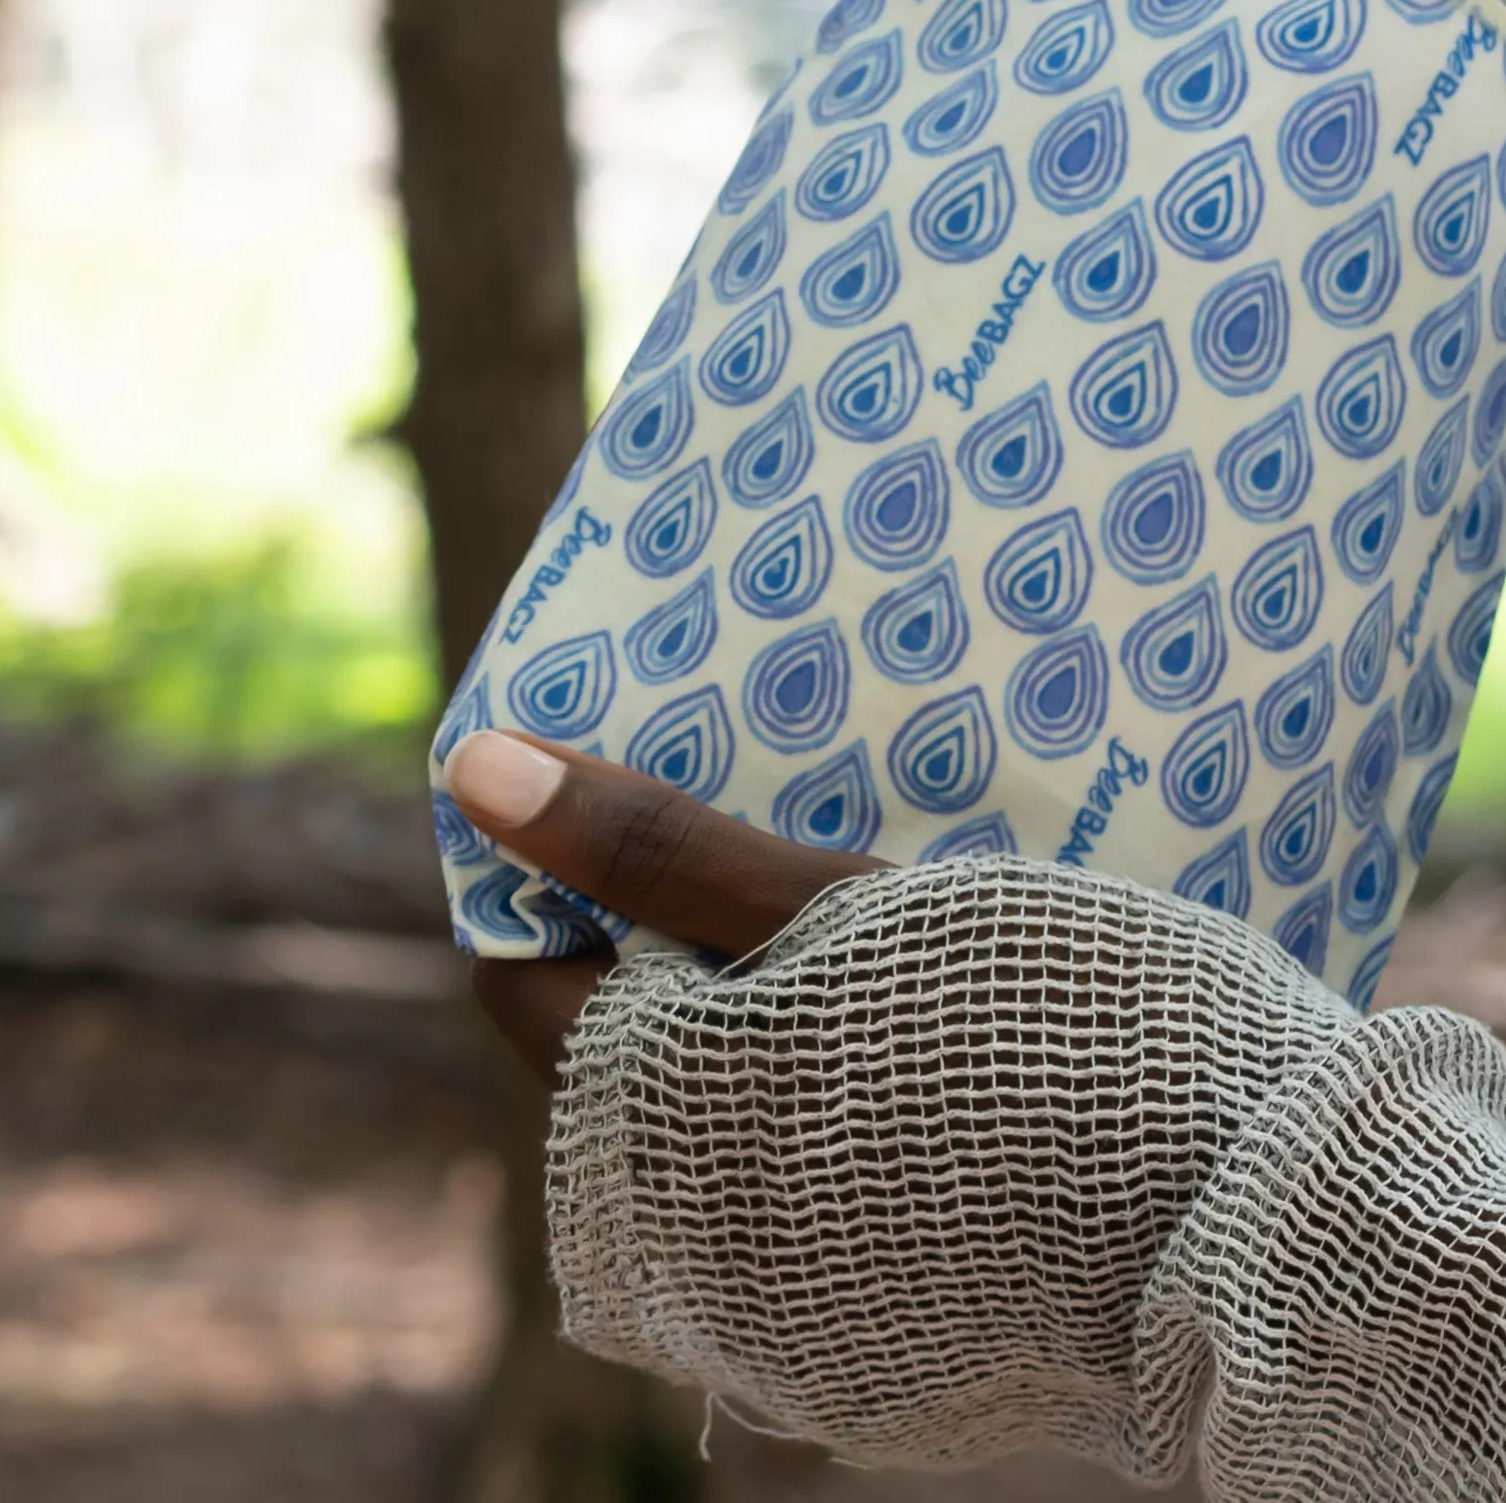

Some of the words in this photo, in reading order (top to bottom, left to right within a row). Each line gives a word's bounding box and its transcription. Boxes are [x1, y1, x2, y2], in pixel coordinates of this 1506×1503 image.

[1394, 6, 1497, 166] BeeBAGZ
[933, 253, 1046, 411] BeeBAGZ
[498, 505, 611, 644] BeeBAGZ
